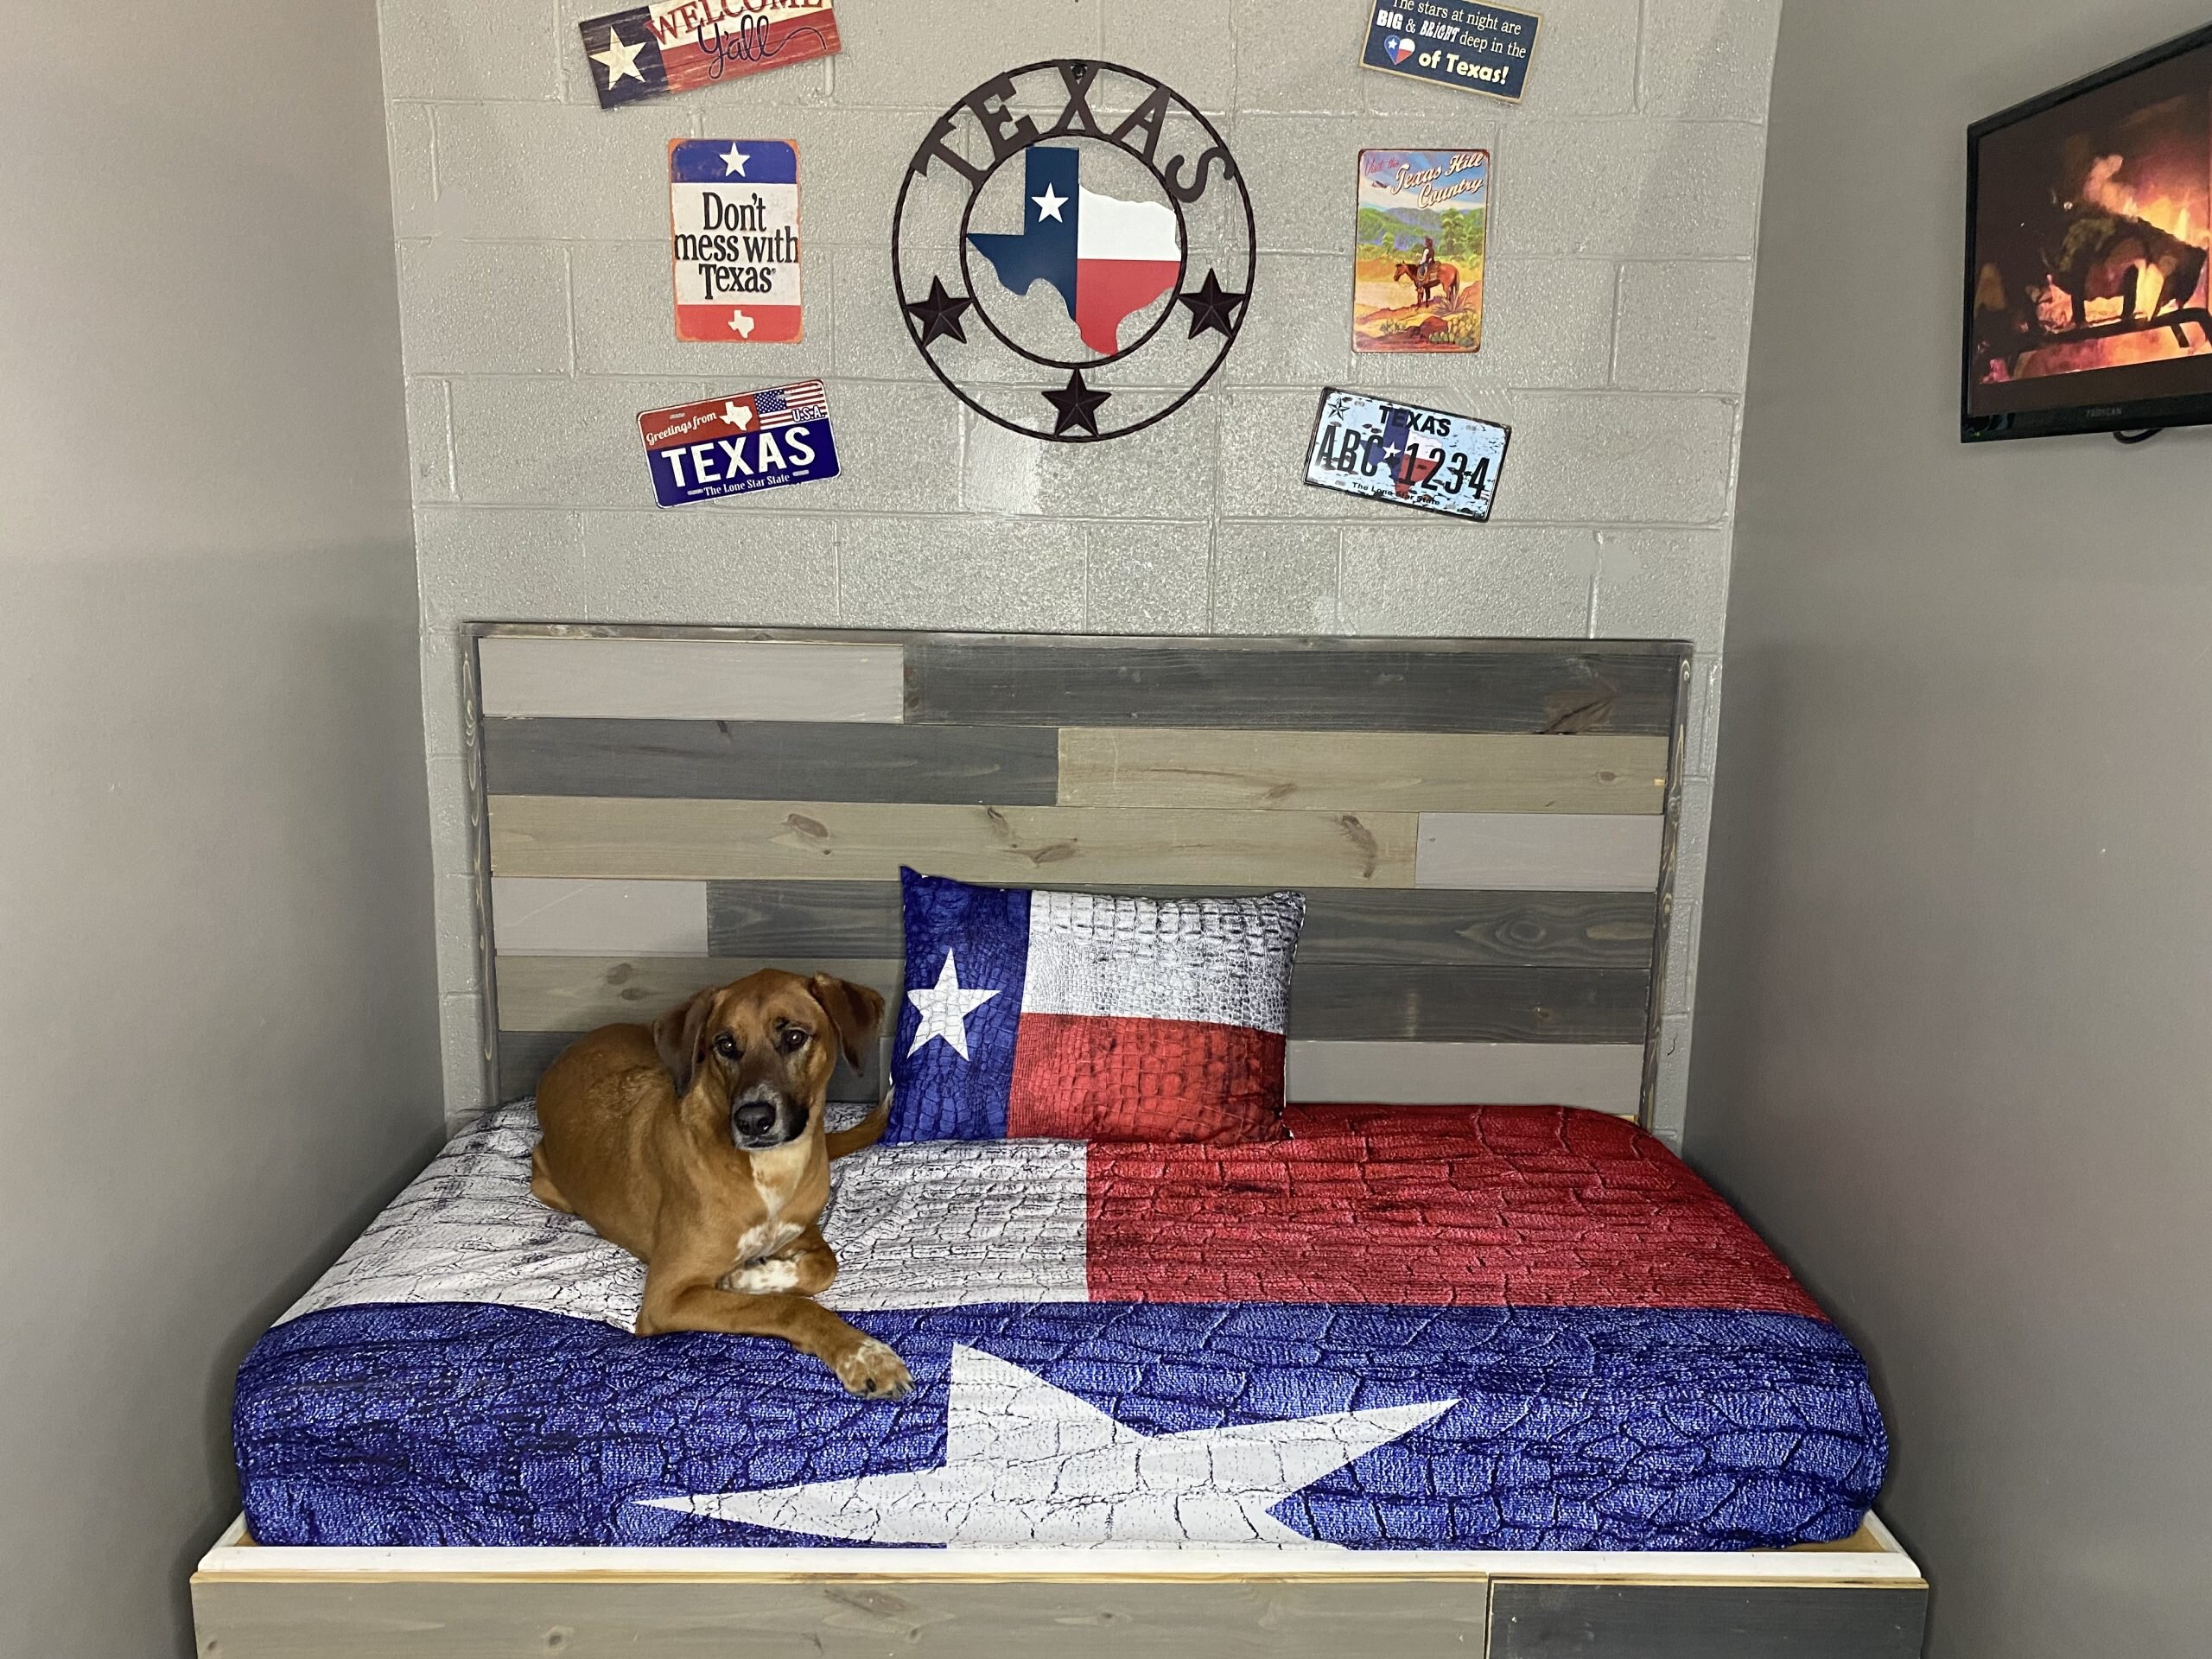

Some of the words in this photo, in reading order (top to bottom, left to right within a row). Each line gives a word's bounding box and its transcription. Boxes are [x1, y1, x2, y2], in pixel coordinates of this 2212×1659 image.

[644, 0, 822, 45] WELCO
[1376, 10, 1403, 30] BIG
[1405, 19, 1416, 33] &
[1459, 31, 1488, 53] deep
[1491, 37, 1503, 53] in
[1507, 41, 1526, 59] the
[1417, 3, 1448, 19] stars
[1452, 10, 1464, 22] at
[1466, 11, 1498, 31] night
[1501, 21, 1522, 35] are
[1418, 50, 1442, 69] of
[1446, 54, 1510, 85] Texas!
[912, 60, 1236, 203] TEXAS
[1390, 162, 1442, 195] Texas
[1445, 152, 1483, 177] Hill
[1417, 177, 1484, 208] Country
[702, 192, 766, 232] Don't
[675, 233, 740, 263] mess
[744, 226, 798, 263] with
[646, 420, 692, 445] Greetings
[691, 412, 717, 430] from
[791, 404, 826, 423] U.S.A.
[1379, 405, 1452, 437] TEXAS
[661, 427, 816, 487] TEXAS
[1315, 424, 1382, 477] ABC
[1399, 443, 1491, 499] 1234
[703, 485, 721, 497] The
[723, 482, 746, 493] Lone
[747, 479, 766, 490] Star
[767, 474, 790, 486] State
